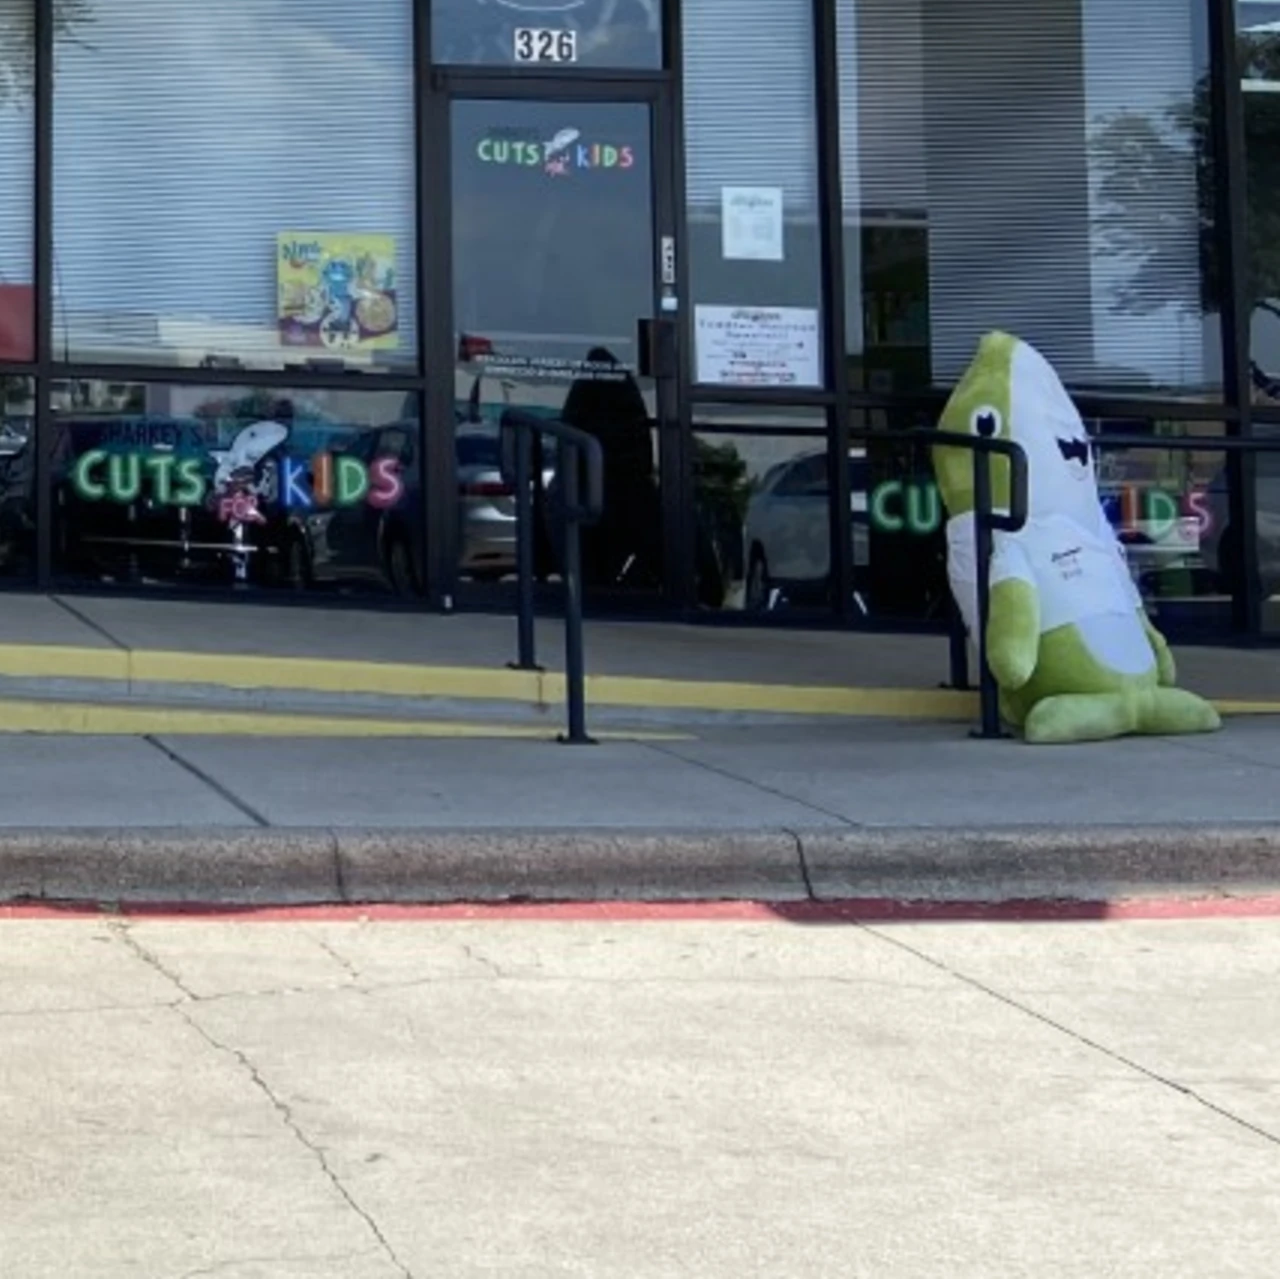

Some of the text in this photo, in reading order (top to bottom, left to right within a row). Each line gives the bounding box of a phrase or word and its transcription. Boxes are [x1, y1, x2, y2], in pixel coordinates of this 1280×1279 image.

[517, 31, 573, 60] 326
[477, 140, 539, 166] CUTS
[576, 144, 634, 168] KIDS
[72, 448, 403, 524] CUTS FOR KIDS
[870, 480, 1213, 542] CU IDS
